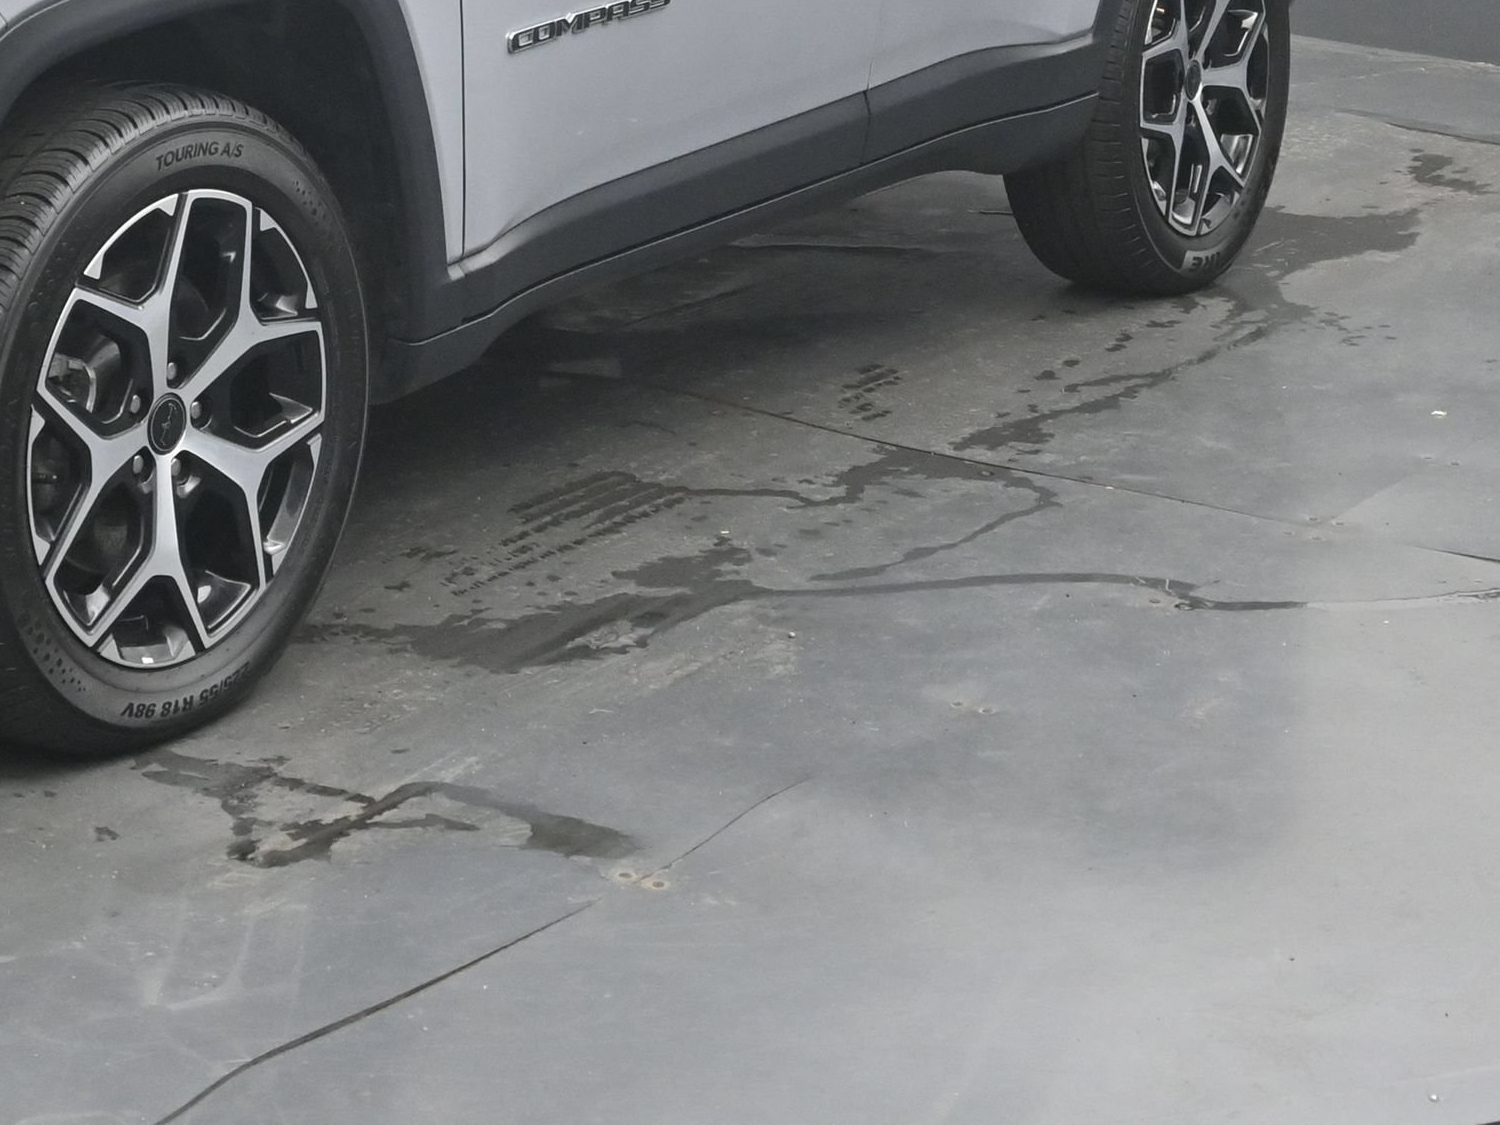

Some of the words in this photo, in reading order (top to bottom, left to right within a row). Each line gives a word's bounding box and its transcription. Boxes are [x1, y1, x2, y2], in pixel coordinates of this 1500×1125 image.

[156, 141, 219, 171] TOURING
[220, 141, 244, 159] A/S
[120, 701, 157, 719] 98V
[160, 694, 194, 717] R18
